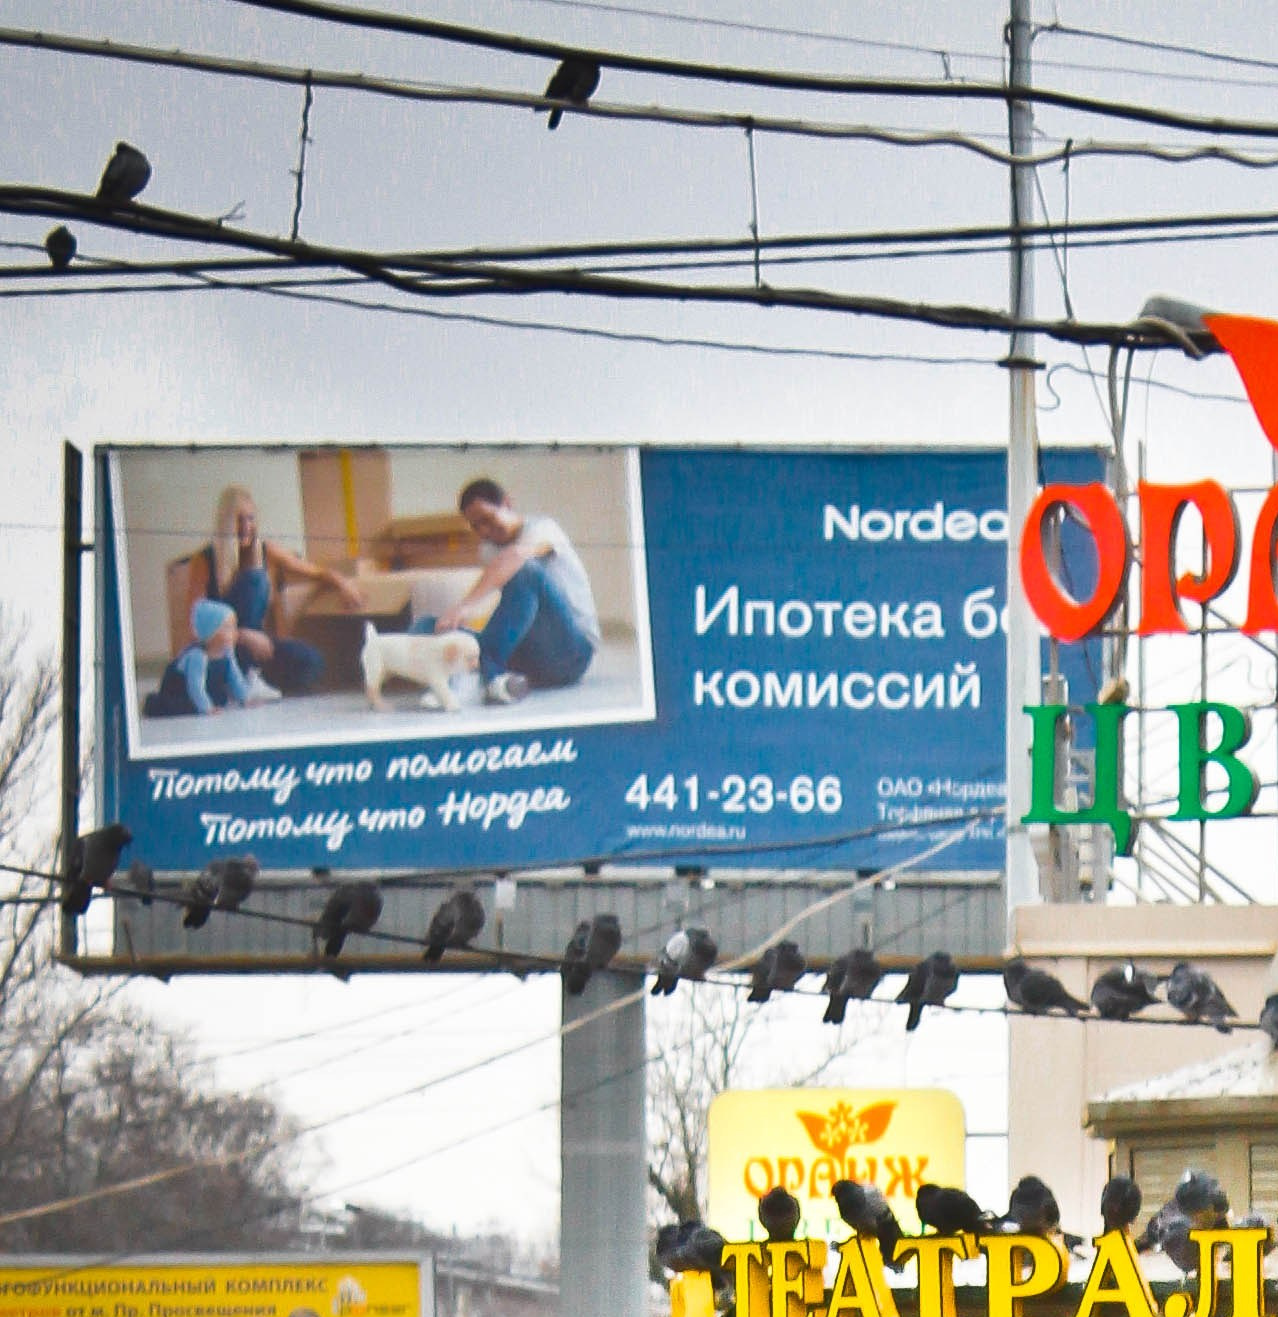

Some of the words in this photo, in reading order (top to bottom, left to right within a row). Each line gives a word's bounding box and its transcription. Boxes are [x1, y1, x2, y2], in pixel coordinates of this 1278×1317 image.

[823, 502, 1008, 541] Nordea
[695, 584, 944, 638] Ипотека
[694, 661, 981, 709] комиссий
[148, 763, 299, 805] Потому
[305, 758, 373, 786] что
[386, 737, 578, 781] помогаем
[877, 776, 922, 798] ОАО
[625, 773, 843, 814] 441-23-66
[200, 811, 354, 851] Потому
[358, 805, 426, 833] что
[436, 785, 571, 830] Нордеа
[743, 1155, 930, 1199] ОРАНЖ
[226, 1276, 328, 1295] КОМПЛЕКС
